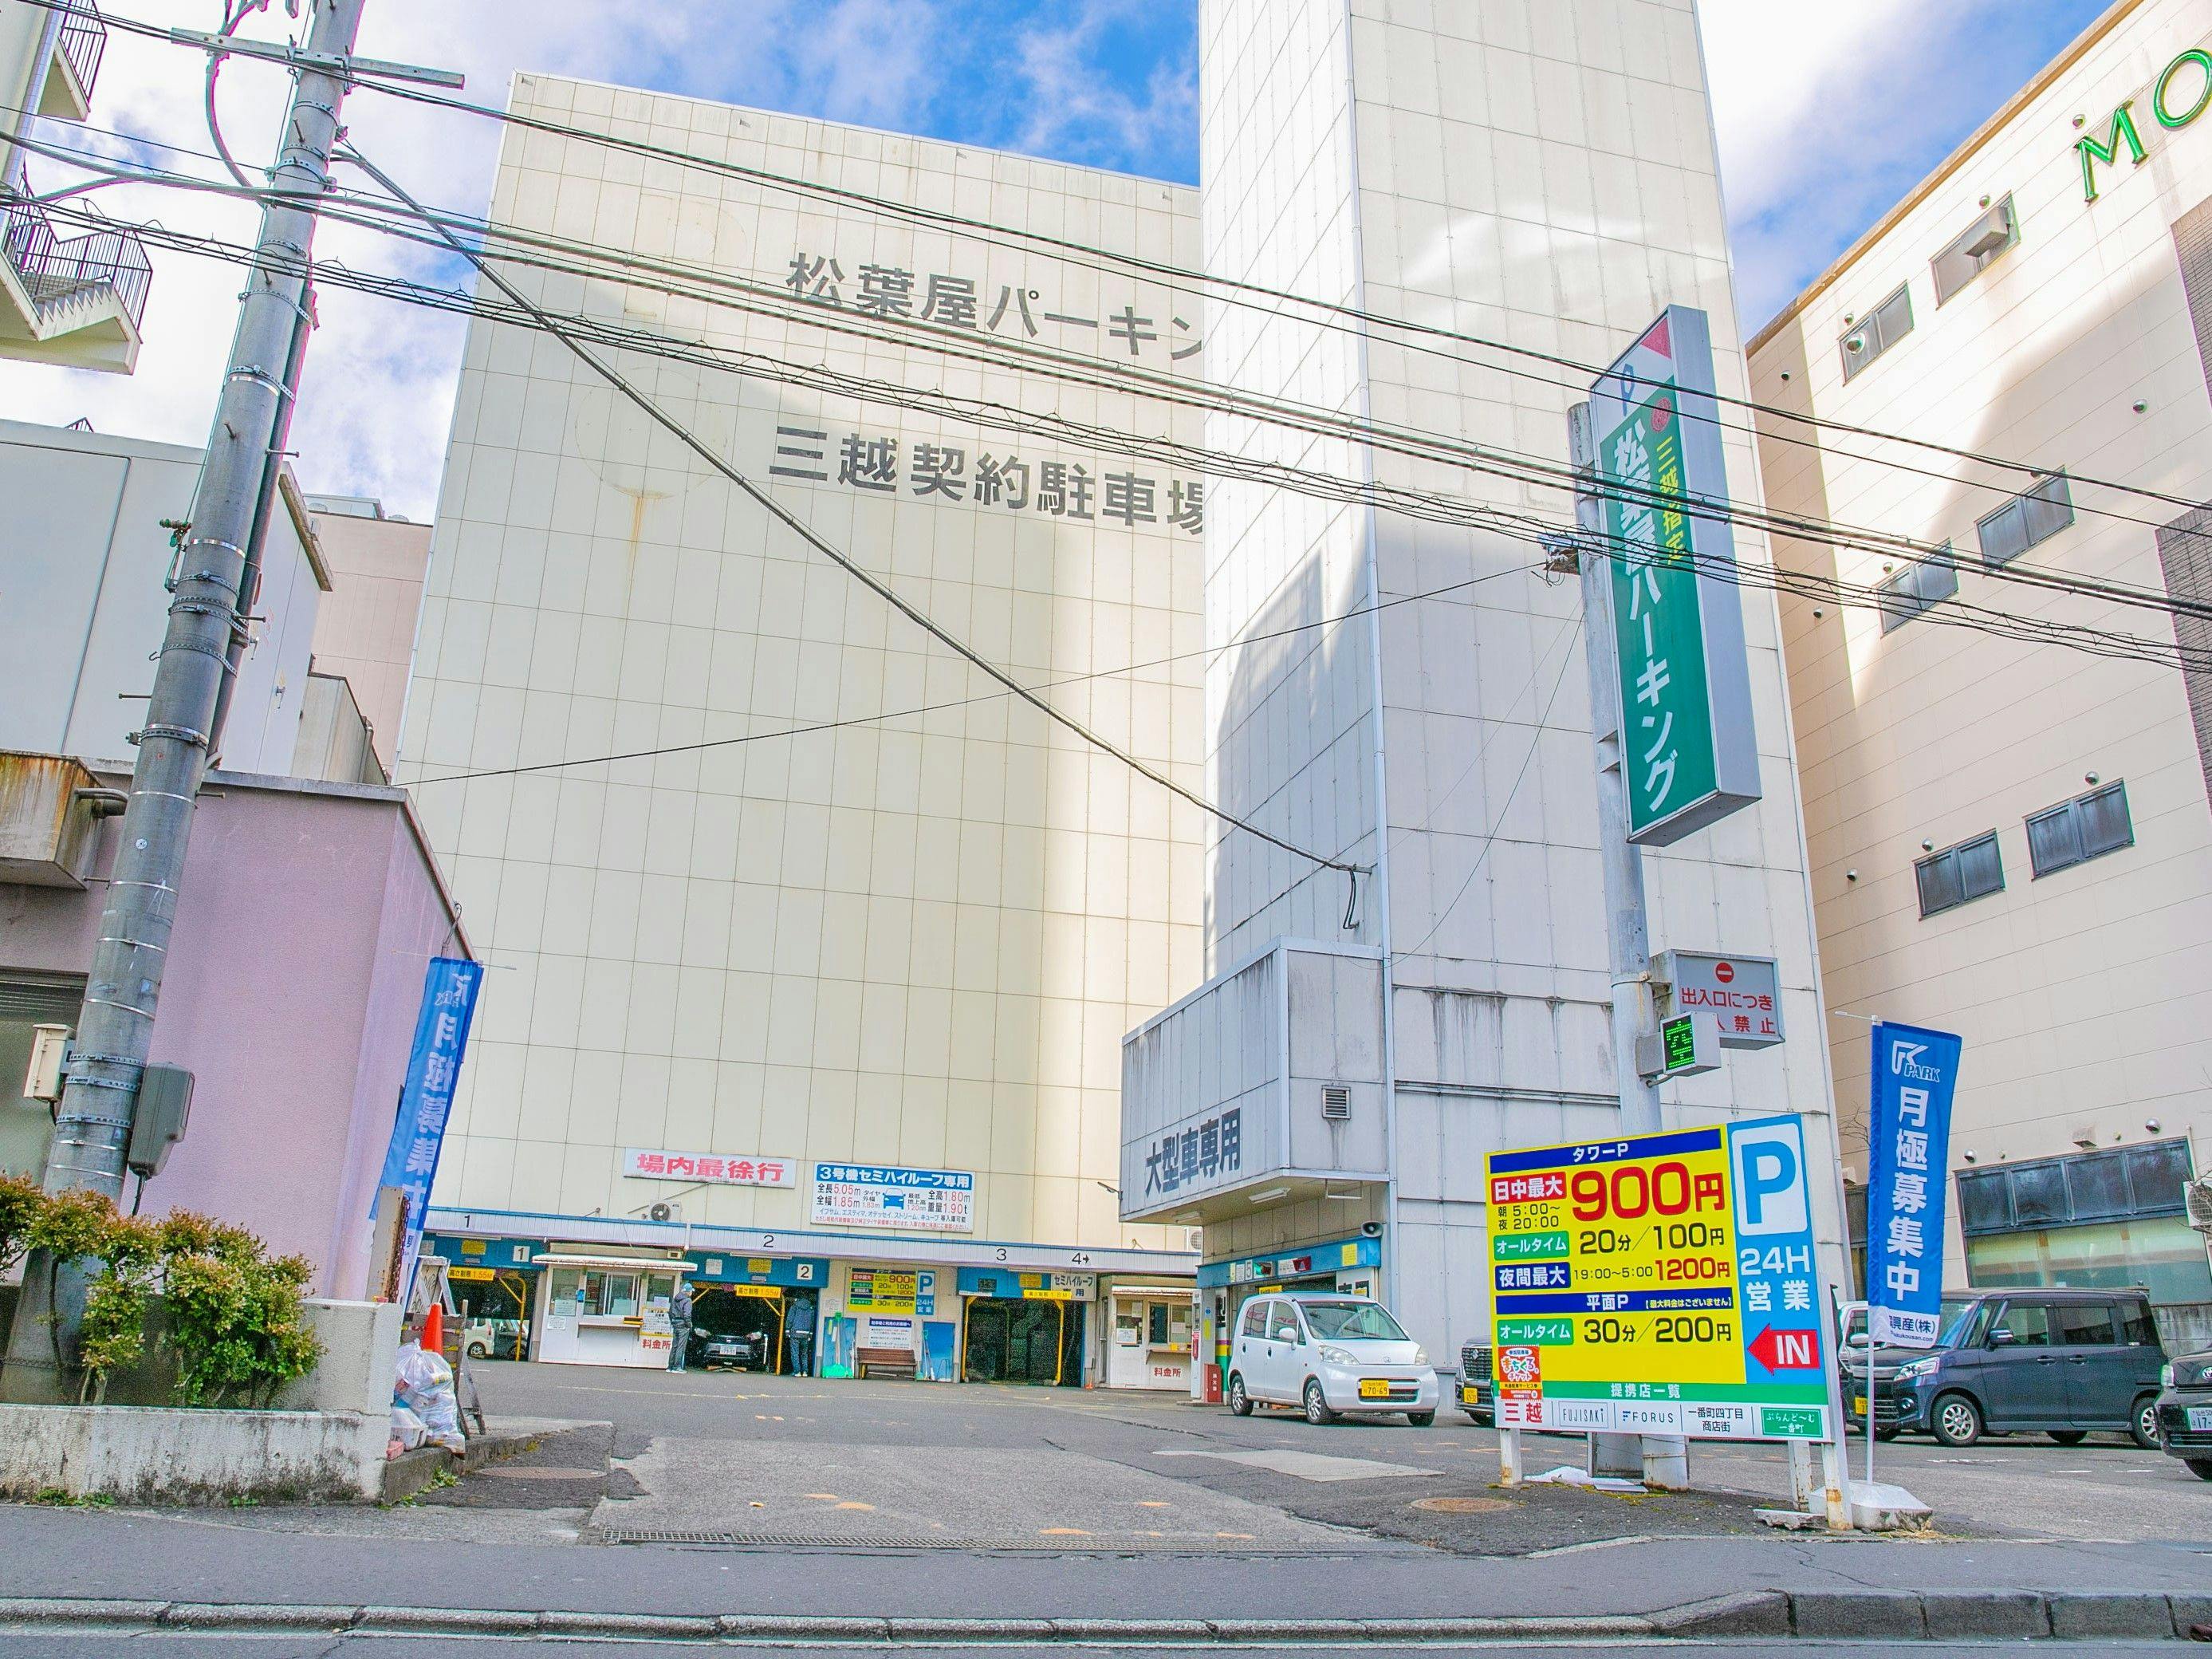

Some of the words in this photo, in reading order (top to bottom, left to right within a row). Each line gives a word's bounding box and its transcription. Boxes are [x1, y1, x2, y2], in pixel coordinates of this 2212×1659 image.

[785, 252, 1202, 361] 松葉屋パーキン
[769, 426, 1203, 535] 三越契約駐車場
[1681, 987, 1773, 1011] 出入口につき
[1666, 1020, 1694, 1069] 空
[1904, 1063, 1940, 1082] PARK
[1145, 1107, 1241, 1197] 大型車専用
[1572, 1142, 1628, 1163] タワーP
[637, 1153, 785, 1183] 場内最徐行
[819, 1166, 970, 1188] 3号機セミハイルーフ専用
[1494, 1176, 1564, 1202] 日中最大
[1571, 1162, 1726, 1221] 900円
[1741, 1141, 1797, 1224] P
[1886, 1086, 1930, 1301] 月極募集中
[1498, 1205, 1507, 1217] 朝
[464, 1215, 470, 1228] 1
[1498, 1219, 1508, 1231] 夜
[1513, 1216, 1559, 1230] 20:00
[763, 1235, 774, 1248] 2
[1496, 1237, 1567, 1255] オールタイム
[518, 1247, 525, 1260] 1
[996, 1247, 1007, 1261] 3
[1071, 1252, 1082, 1265] 4
[1740, 1246, 1810, 1276] 24H
[801, 1266, 809, 1279] 2
[1053, 1275, 1093, 1287] セミハイルーフ
[1499, 1266, 1566, 1288] 夜間最大
[1655, 1256, 1730, 1281] 1200円
[919, 1275, 933, 1293] P
[1586, 1294, 1629, 1311] 平面P
[1746, 1280, 1811, 1312] 営業
[1500, 1322, 1571, 1339] オールタイム
[643, 1338, 671, 1350] 料金所
[1777, 1334, 1810, 1365] IN
[1154, 1367, 1182, 1377] 料金所
[1611, 1383, 1681, 1399] 提携店一覧
[1504, 1401, 1544, 1425] 三越
[1688, 1407, 1743, 1420] 一番町四丁目
[1702, 1421, 1730, 1432] 商店街
[1779, 1423, 1805, 1434] 一番町
